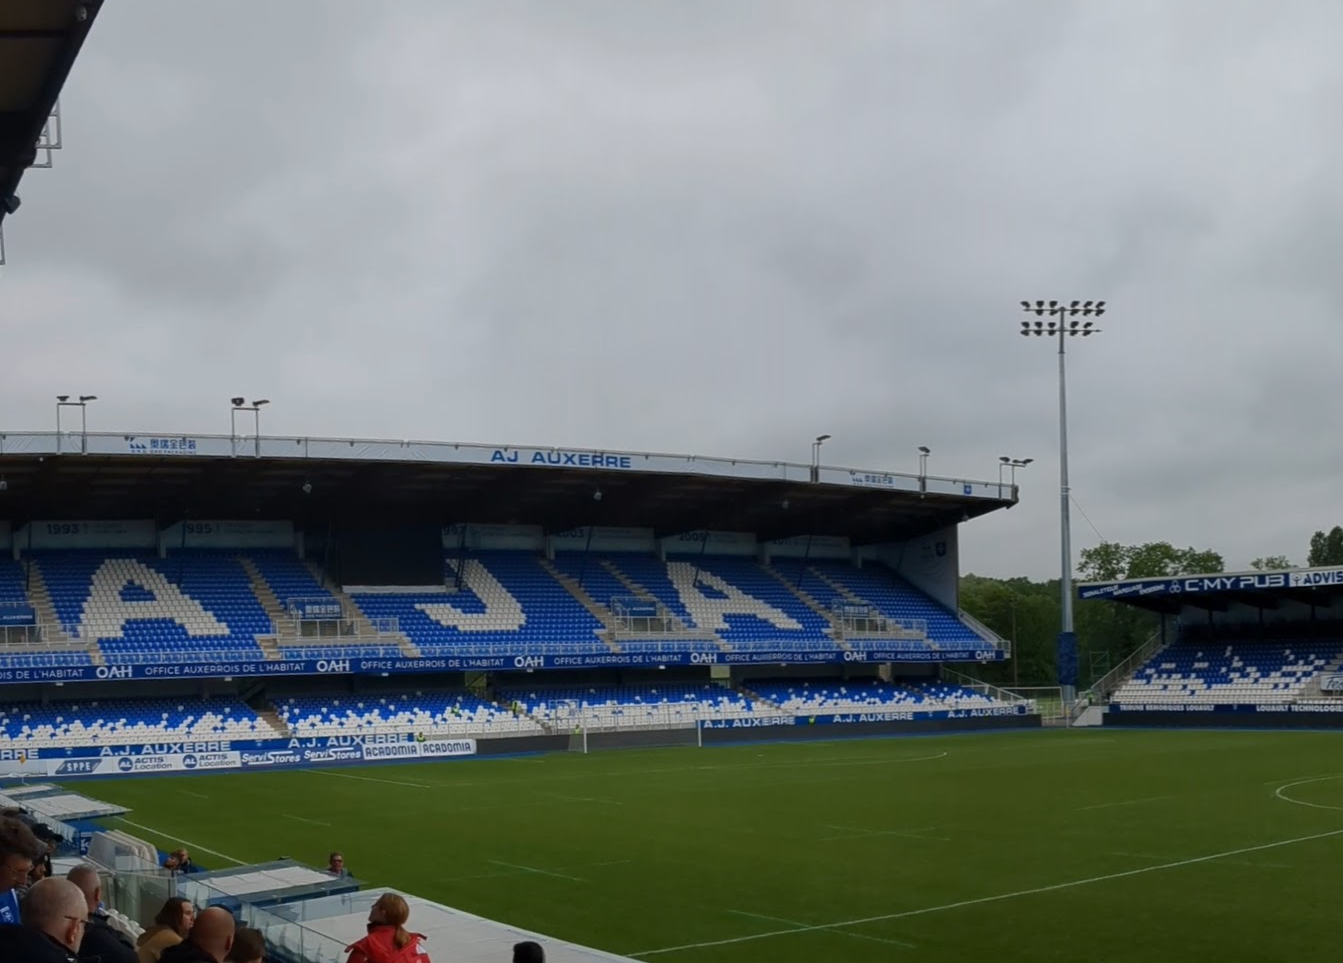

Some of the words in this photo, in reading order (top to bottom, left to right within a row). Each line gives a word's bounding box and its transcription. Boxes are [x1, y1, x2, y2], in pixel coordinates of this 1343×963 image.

[491, 450, 518, 462] AJ
[531, 452, 632, 469] AUXERRE
[48, 523, 79, 535] 1993
[183, 523, 212, 534] 995
[1239, 574, 1285, 588] PUB
[553, 656, 582, 665] OFFICE
[584, 656, 630, 665] AUXERROIS
[632, 655, 643, 664] DE
[645, 654, 682, 663] L'HABITAT
[690, 652, 717, 663] OAH
[725, 654, 750, 662] OFFICE
[793, 653, 803, 661] DE
[804, 653, 836, 661] L'HABITAT
[844, 651, 867, 661] OAH
[873, 652, 895, 660] OFFICE
[932, 652, 941, 660] DE
[941, 651, 970, 660] L'HABITAT
[975, 651, 996, 660] OAH
[316, 661, 350, 672] OAH
[360, 661, 392, 670] OFFICE
[394, 660, 446, 669] AUXERROIS
[448, 659, 461, 668] DE
[463, 658, 505, 668] L'HABITAT
[514, 656, 544, 667] OAH
[16, 670, 30, 679] DE
[33, 669, 84, 679] L'HABITAT
[96, 666, 133, 679] OAH
[144, 666, 181, 676] OFFICE
[183, 665, 240, 675] AUXERROIS
[242, 664, 256, 674] DE
[259, 662, 305, 672] L'HABITAT
[833, 714, 856, 723] A.J.
[860, 711, 913, 721] AUXERRE
[947, 710, 968, 718] A.J.
[971, 707, 1019, 717] AUXERRE
[703, 720, 729, 728] A.J.
[732, 716, 795, 728] AUXERRE
[288, 738, 322, 748] A.J.
[326, 733, 408, 747] AUXERRE
[100, 746, 135, 757] A.J.
[141, 742, 231, 755] AUXERRE
[365, 745, 418, 757] ACADOMIA
[422, 741, 471, 754] ACADOMIA
[66, 761, 91, 772] SPPE
[134, 762, 172, 770] Location
[199, 758, 236, 767] Location
